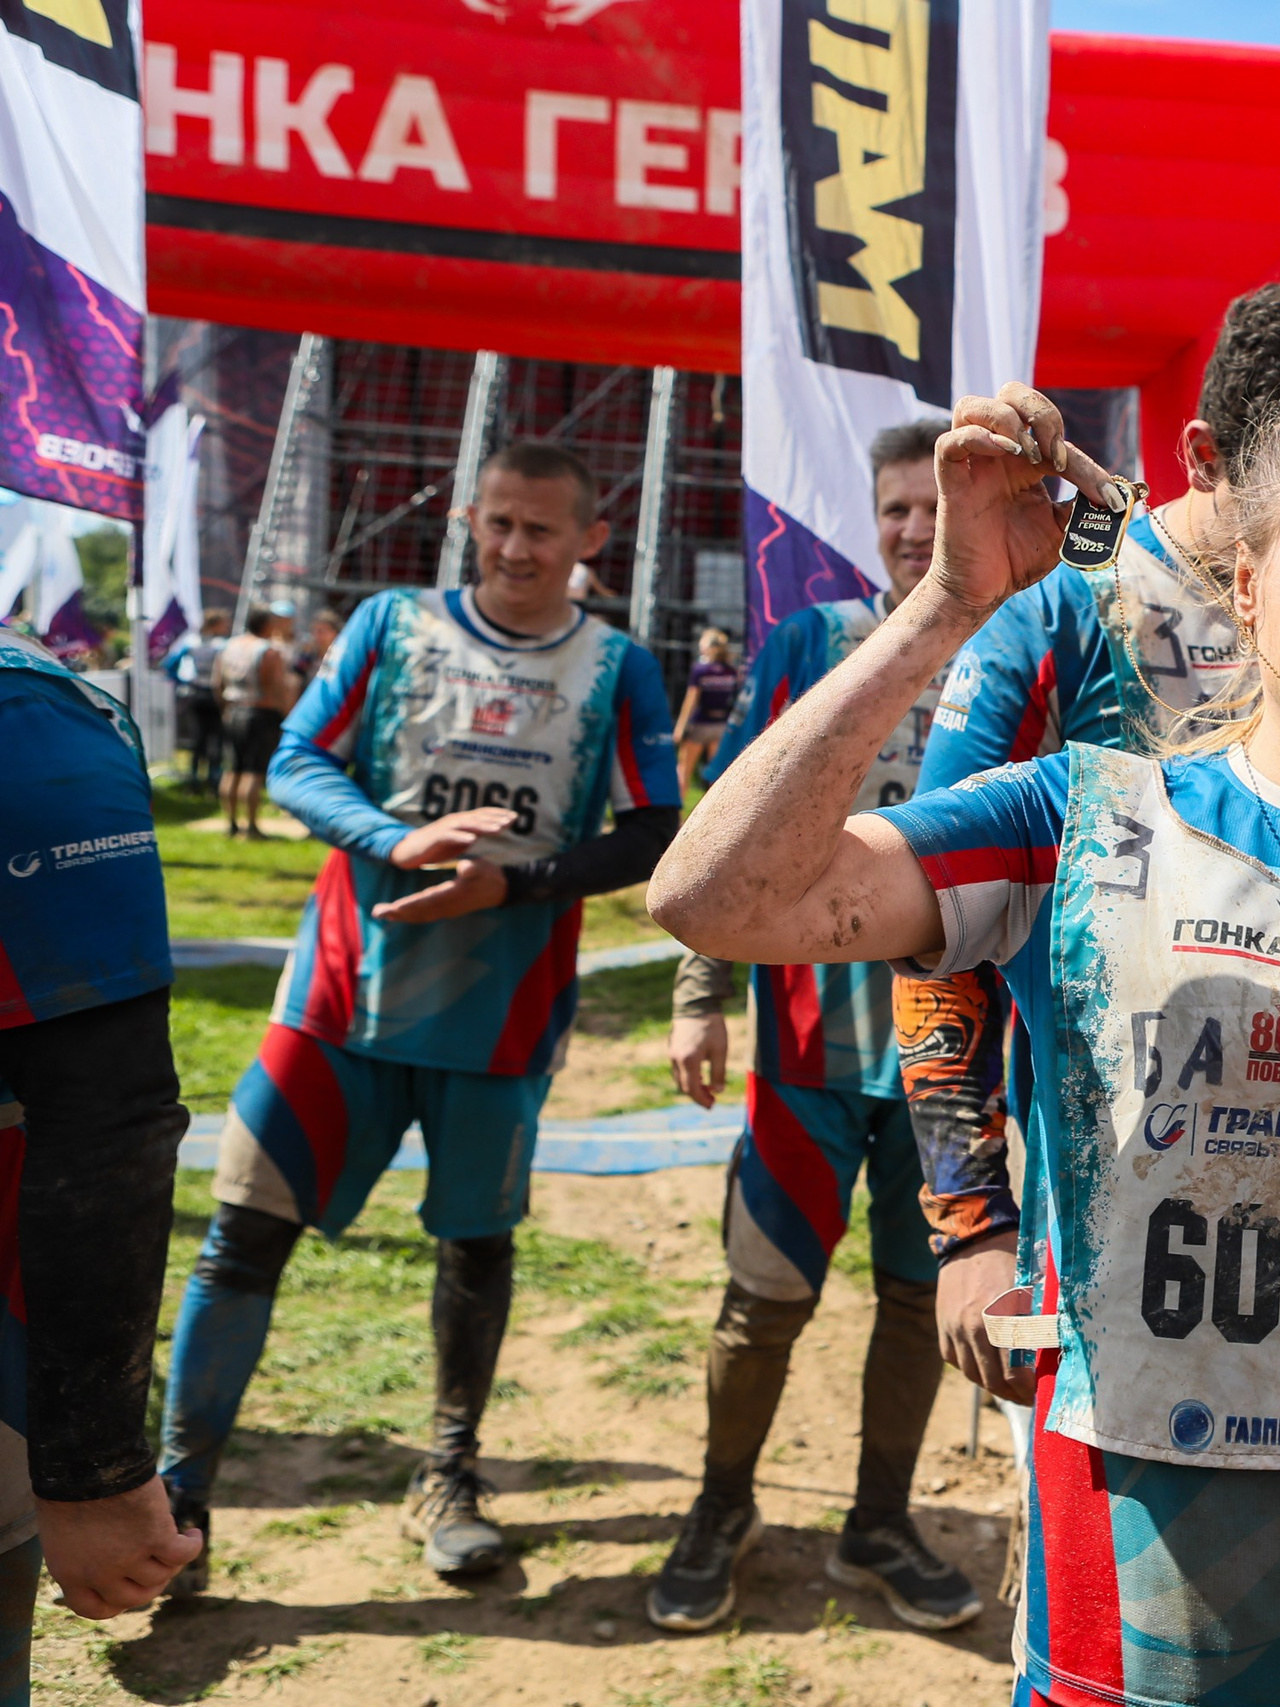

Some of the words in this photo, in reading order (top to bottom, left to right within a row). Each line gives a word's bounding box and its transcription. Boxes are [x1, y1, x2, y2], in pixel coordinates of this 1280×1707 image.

[1083, 512, 1111, 522] ГОНКА
[1077, 522, 1111, 532] ГЕРОЕВ
[1073, 541, 1105, 553] 2025
